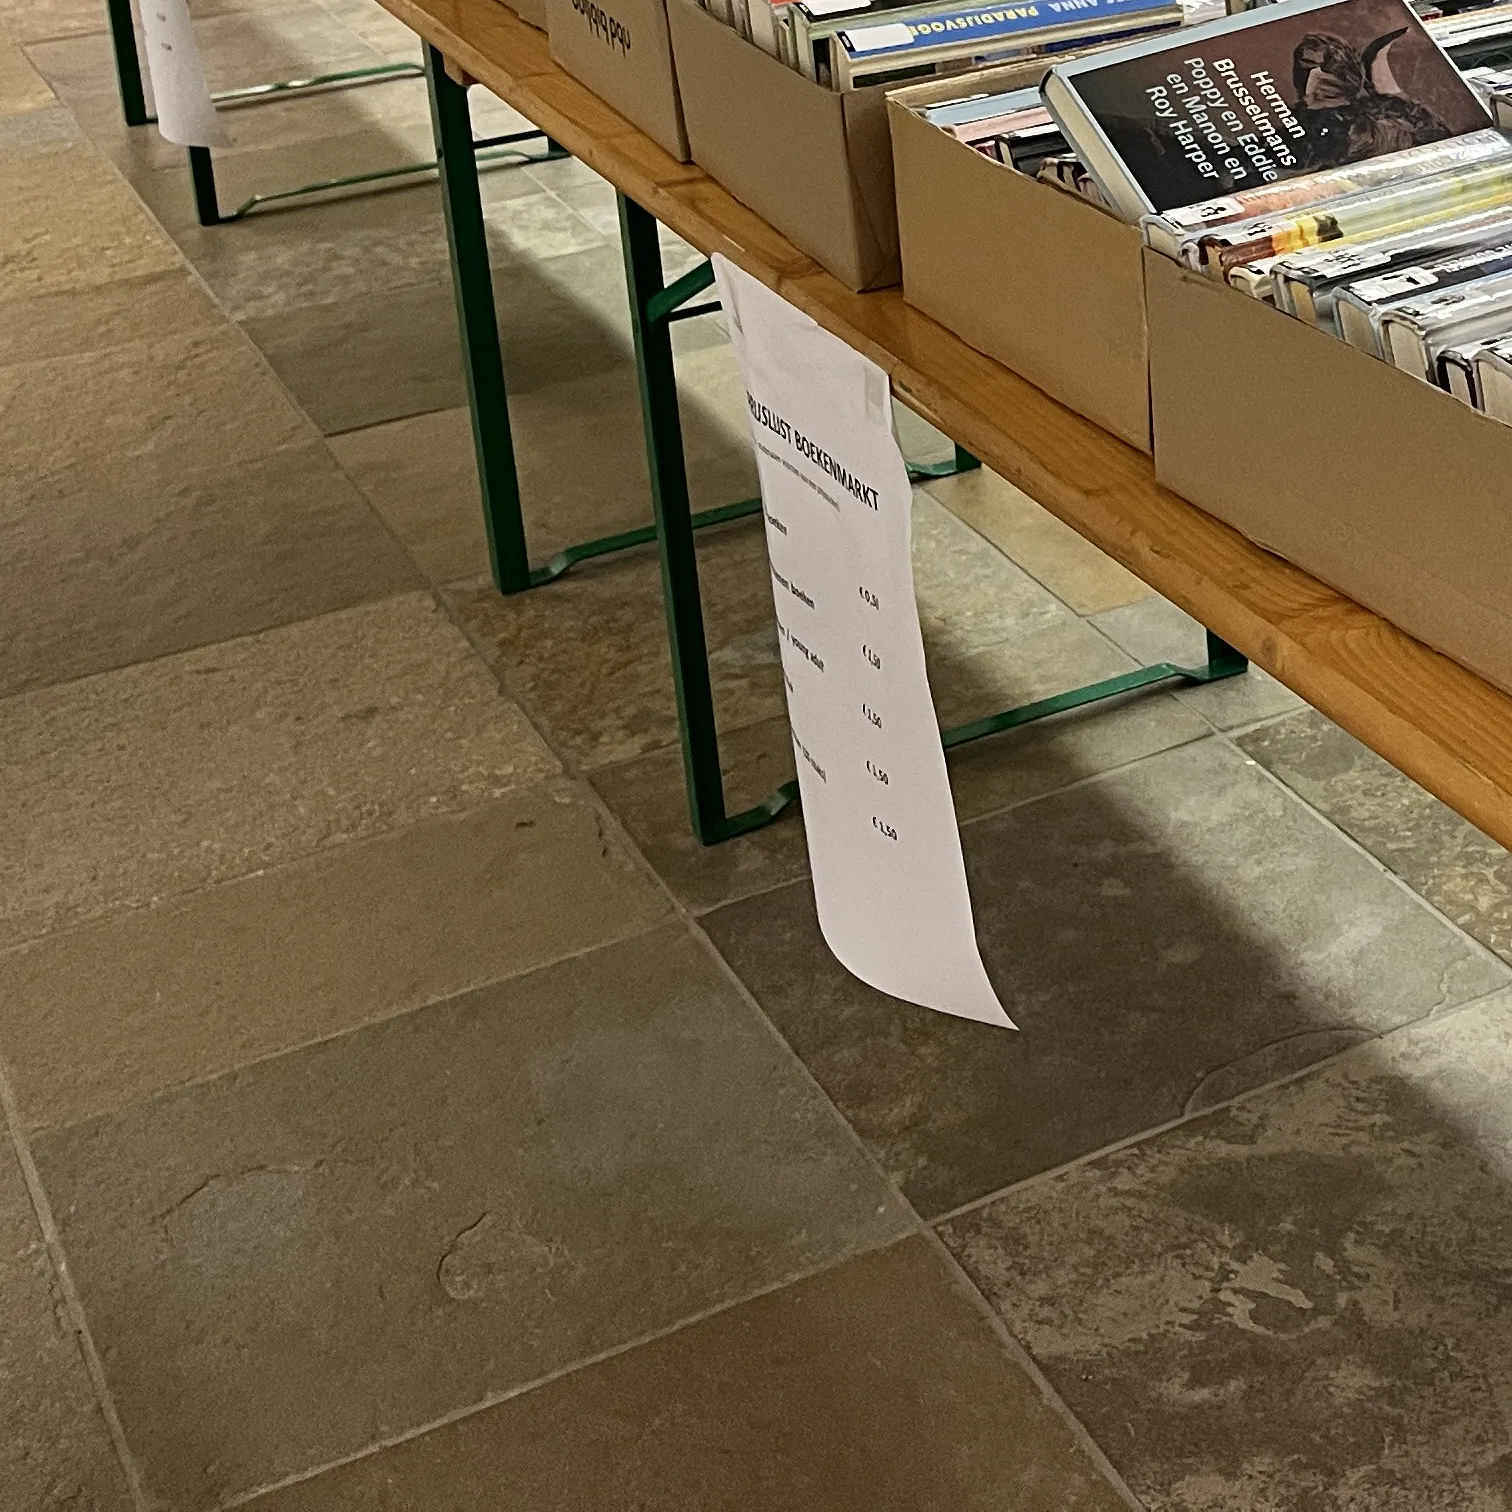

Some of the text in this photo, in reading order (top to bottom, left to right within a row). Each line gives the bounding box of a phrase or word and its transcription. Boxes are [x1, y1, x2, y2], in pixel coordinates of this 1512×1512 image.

[1144, 84, 1219, 179] Roy Harper
[1166, 72, 1247, 180] en Manon en
[1183, 56, 1277, 182] Poppy en Eddie
[1211, 57, 1297, 166] Brusselmans
[1249, 69, 1306, 139] Herman
[794, 429, 879, 510] BOEKENMARKT
[867, 708, 881, 728] 1,50
[872, 764, 888, 785] 1,50
[879, 820, 897, 841] 1,50
